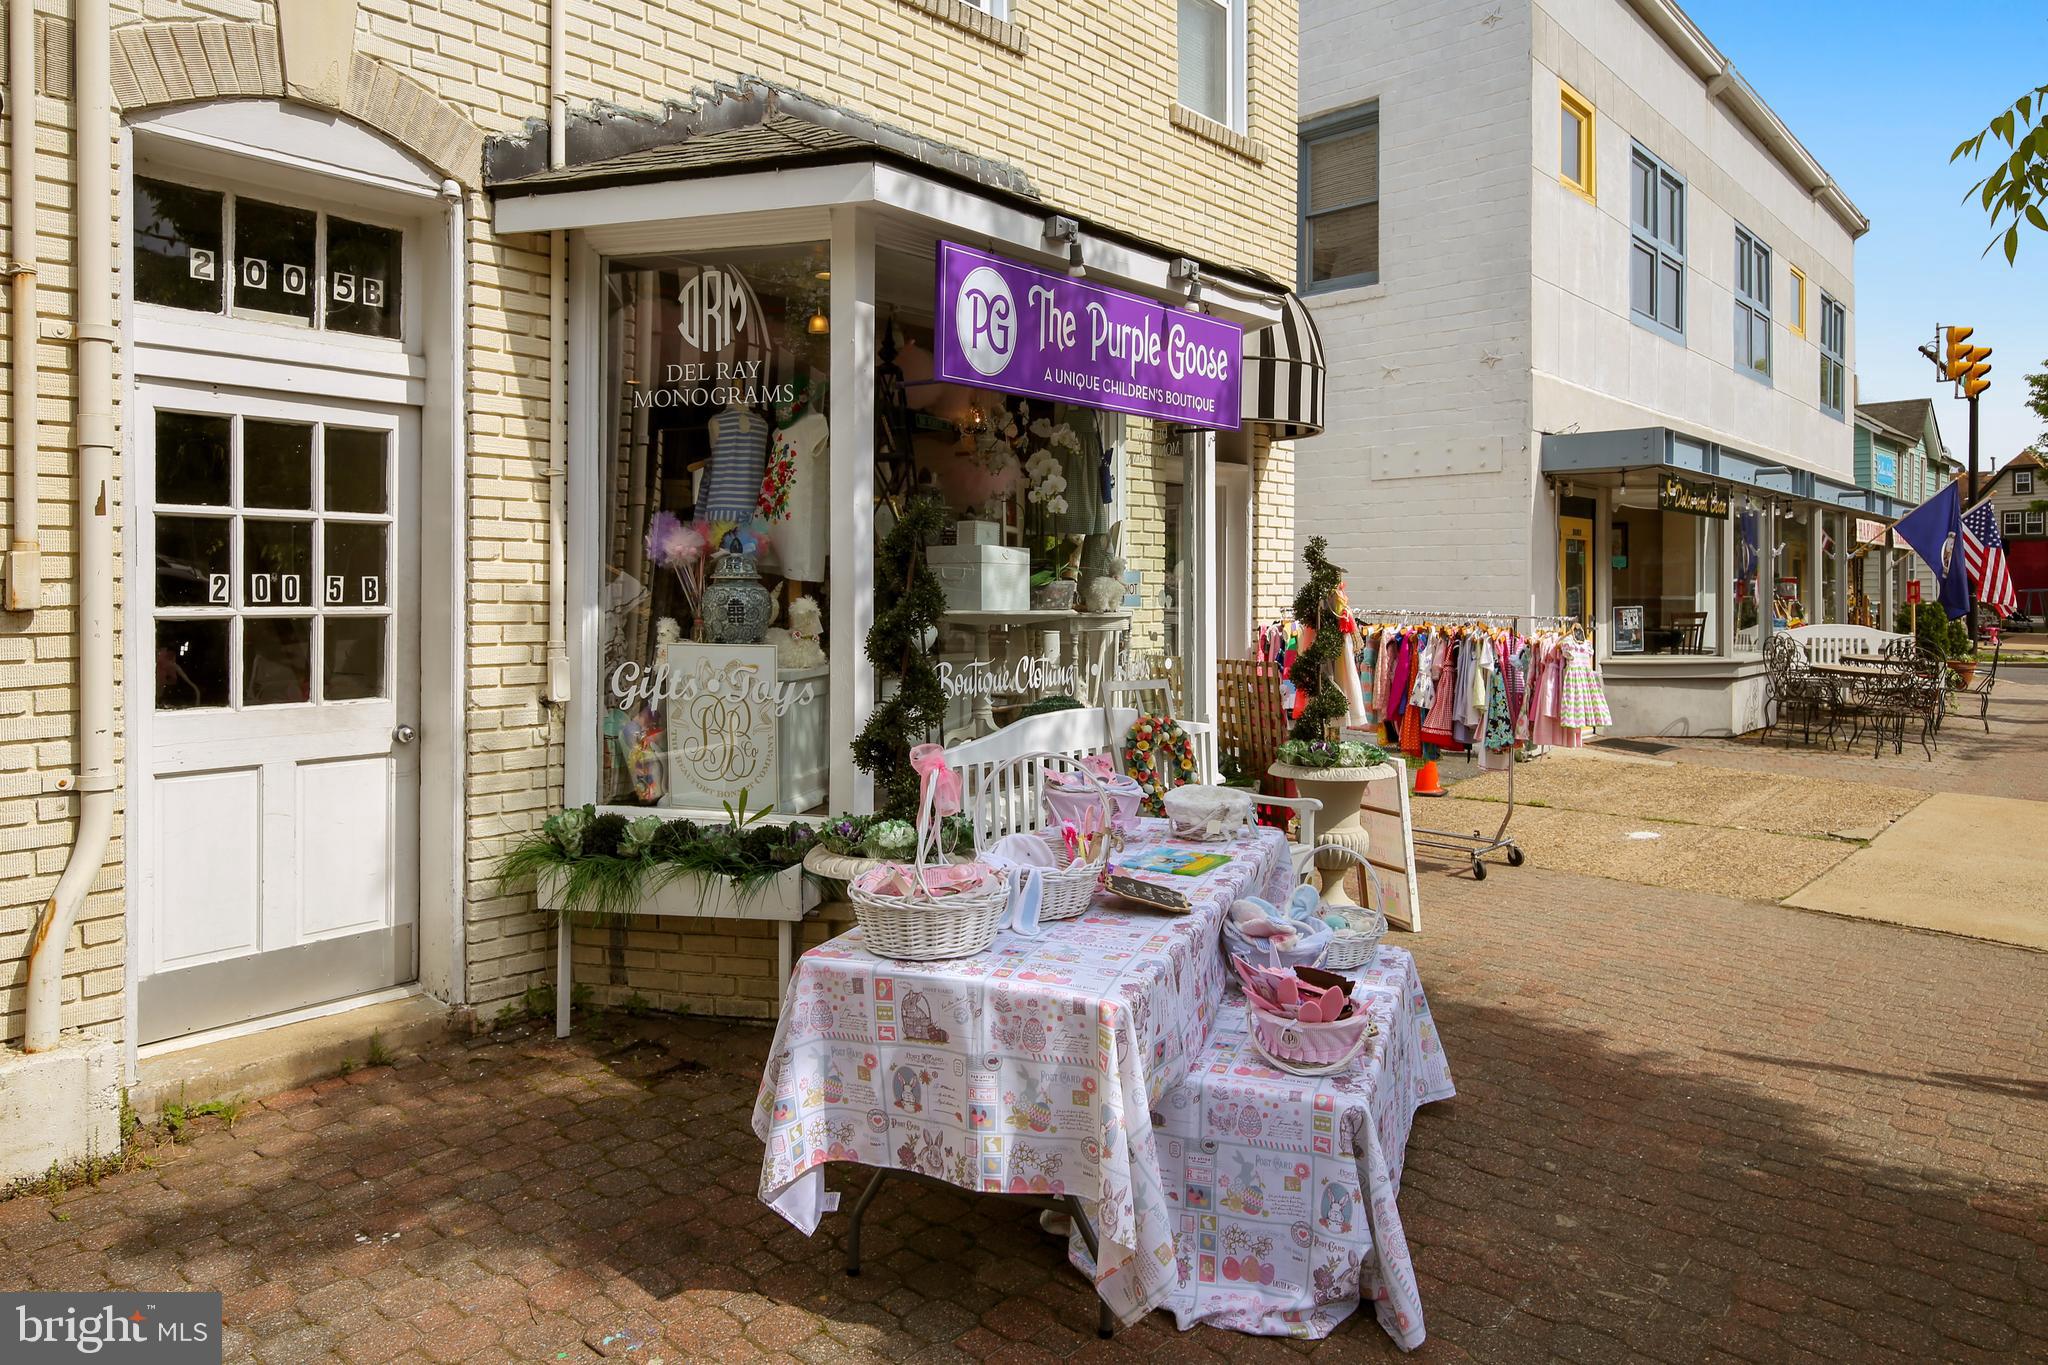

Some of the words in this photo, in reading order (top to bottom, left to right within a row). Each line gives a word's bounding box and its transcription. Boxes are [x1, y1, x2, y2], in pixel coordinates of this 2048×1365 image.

[965, 288, 1011, 355] PG
[1028, 284, 1077, 352] The
[1086, 302, 1162, 380] Purple
[1167, 323, 1229, 381] Goose
[633, 383, 795, 409] MONOGRAMS
[666, 363, 711, 383] DEL
[716, 360, 762, 381] RAY
[1043, 367, 1053, 383] A
[1055, 369, 1100, 392] UNIQUE
[1102, 378, 1164, 404] CHILDREN'S
[1166, 392, 1216, 413] BOUTIQUE
[212, 574, 379, 602] 2005B
[611, 661, 698, 712] Gifts
[723, 664, 815, 718] Toys
[933, 656, 1010, 706] Boutique
[1014, 651, 1076, 697] Clothing
